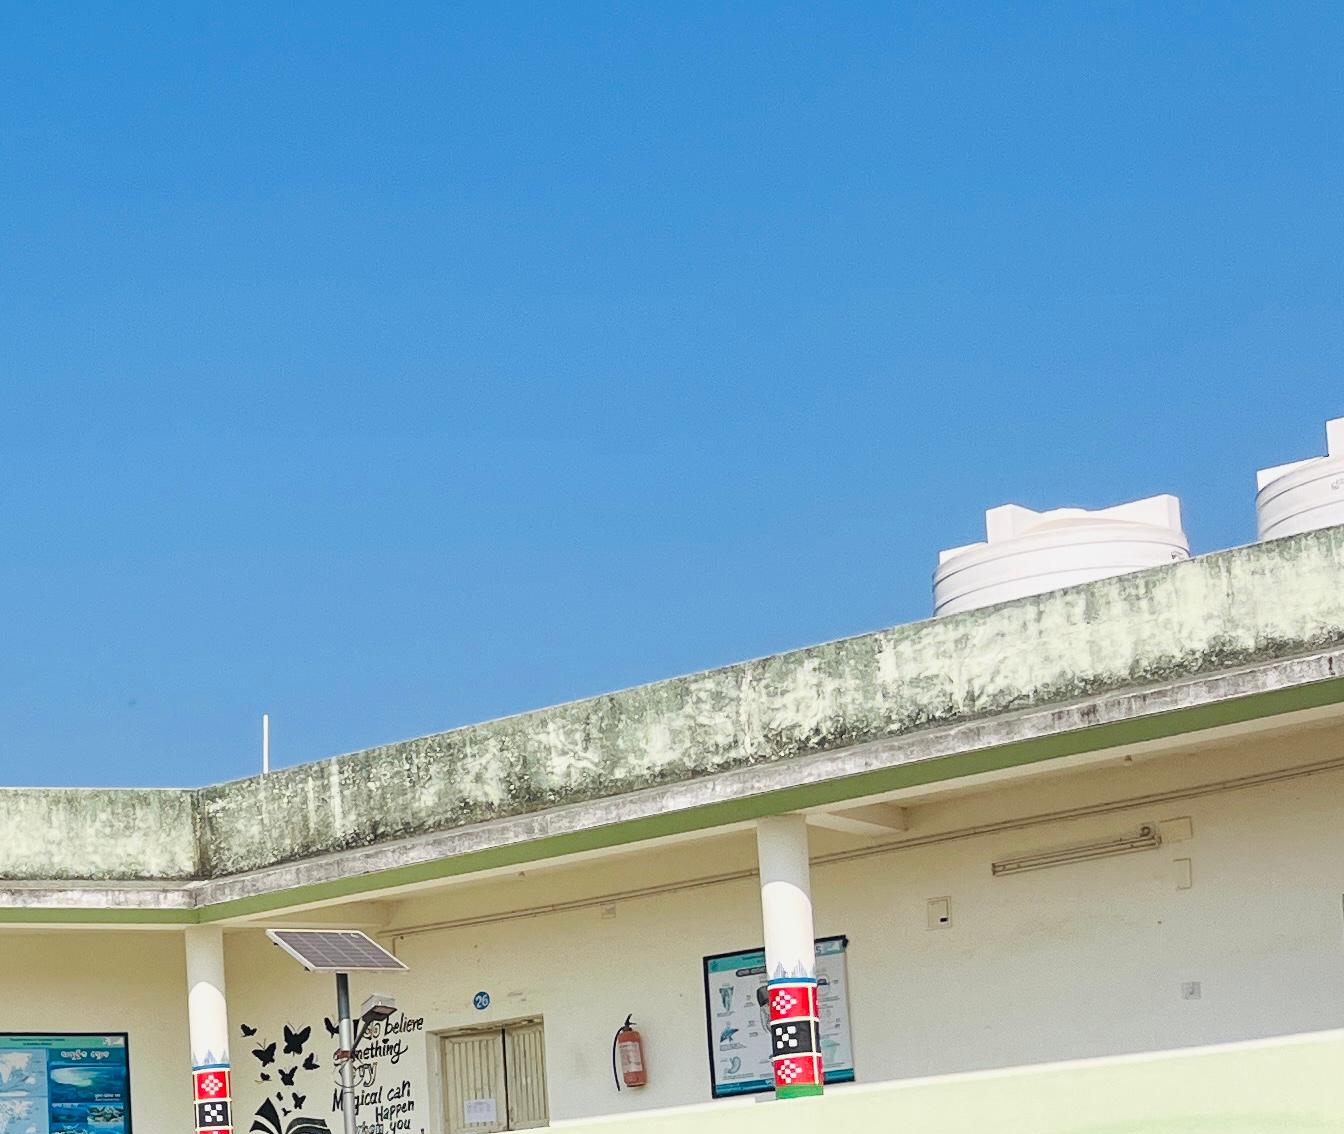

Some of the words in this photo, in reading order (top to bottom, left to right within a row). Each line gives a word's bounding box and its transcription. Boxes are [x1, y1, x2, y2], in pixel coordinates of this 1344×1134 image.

[475, 994, 489, 1008] 26
[332, 1085, 384, 1115] Mgical
[387, 1080, 411, 1101] can
[375, 1100, 415, 1122] Happen
